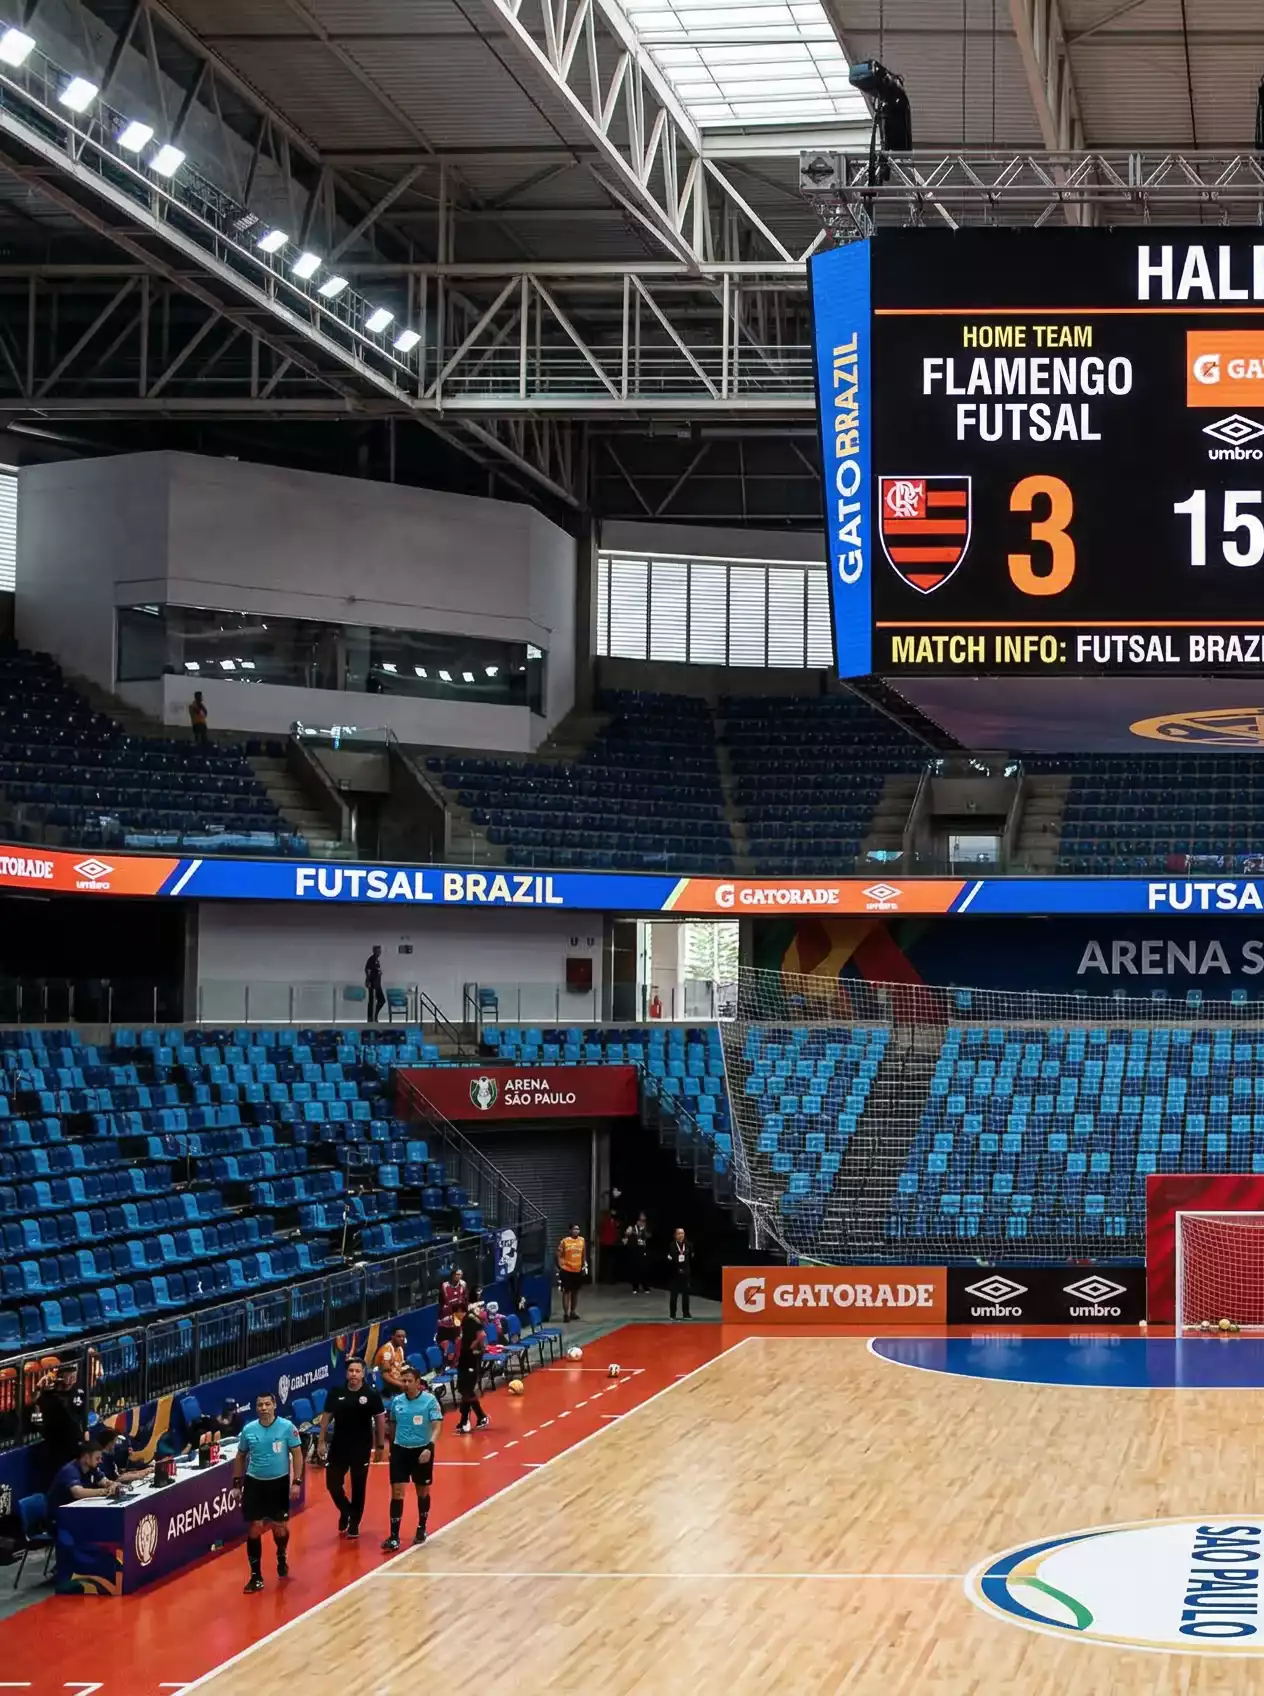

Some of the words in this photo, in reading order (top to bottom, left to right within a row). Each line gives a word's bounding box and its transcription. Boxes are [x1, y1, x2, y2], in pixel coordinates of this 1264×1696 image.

[963, 325, 1026, 347] HOME
[1033, 325, 1092, 347] TEAM
[923, 356, 1133, 395] FLAMENGO
[957, 402, 1101, 441] FUTSAL
[1208, 446, 1263, 460] umbro
[1008, 475, 1075, 595] 3
[892, 636, 985, 662] MATCH
[995, 635, 1066, 662] INFO:
[1077, 635, 1180, 662] FUTSAL
[0, 856, 54, 879] TORADE
[296, 867, 433, 900] FUTSAL
[444, 873, 563, 904] BRAZIL
[740, 888, 840, 905] GATORADE
[1077, 940, 1230, 975] ARENA
[504, 1079, 549, 1091] ARENA
[504, 1091, 531, 1105] SÃO
[535, 1093, 576, 1105] PAULO
[773, 1283, 934, 1307] GATORADE
[971, 1304, 1022, 1318] umbro
[1069, 1304, 1121, 1318] umbro
[167, 1501, 211, 1541] ARENA
[212, 1487, 239, 1519] SÃO
[1178, 1568, 1259, 1638] PAULO
